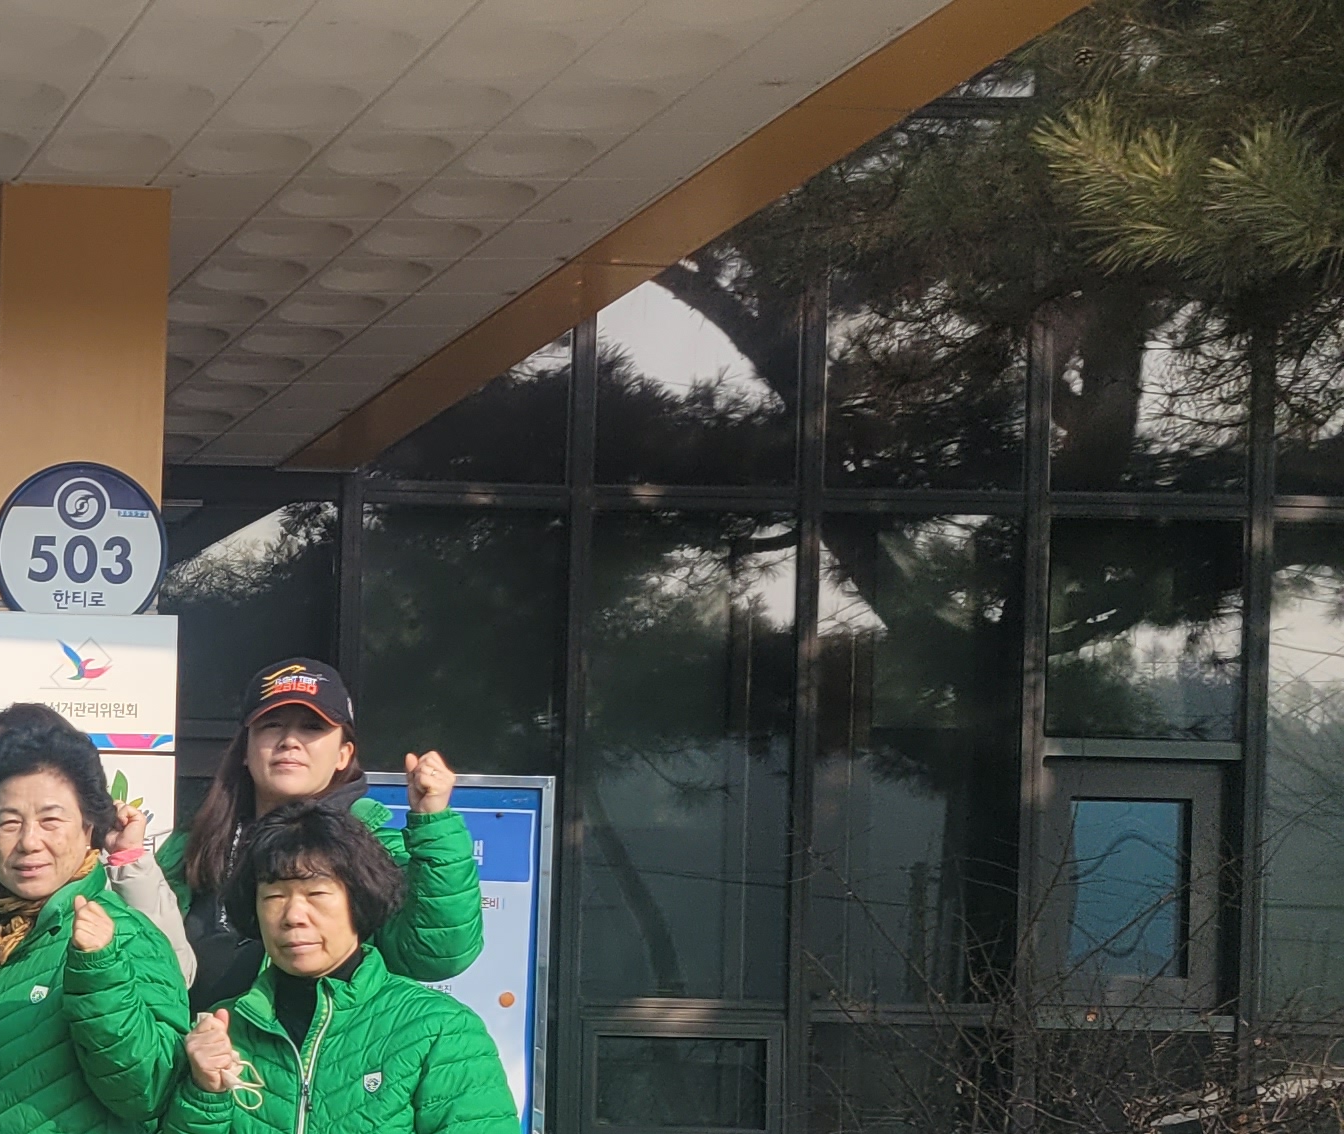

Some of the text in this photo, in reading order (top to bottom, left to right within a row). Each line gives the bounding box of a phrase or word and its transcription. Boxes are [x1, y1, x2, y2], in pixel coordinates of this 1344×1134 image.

[27, 535, 133, 584] 503
[52, 589, 106, 610] 한티로
[50, 702, 138, 718] 선거관리위원회
